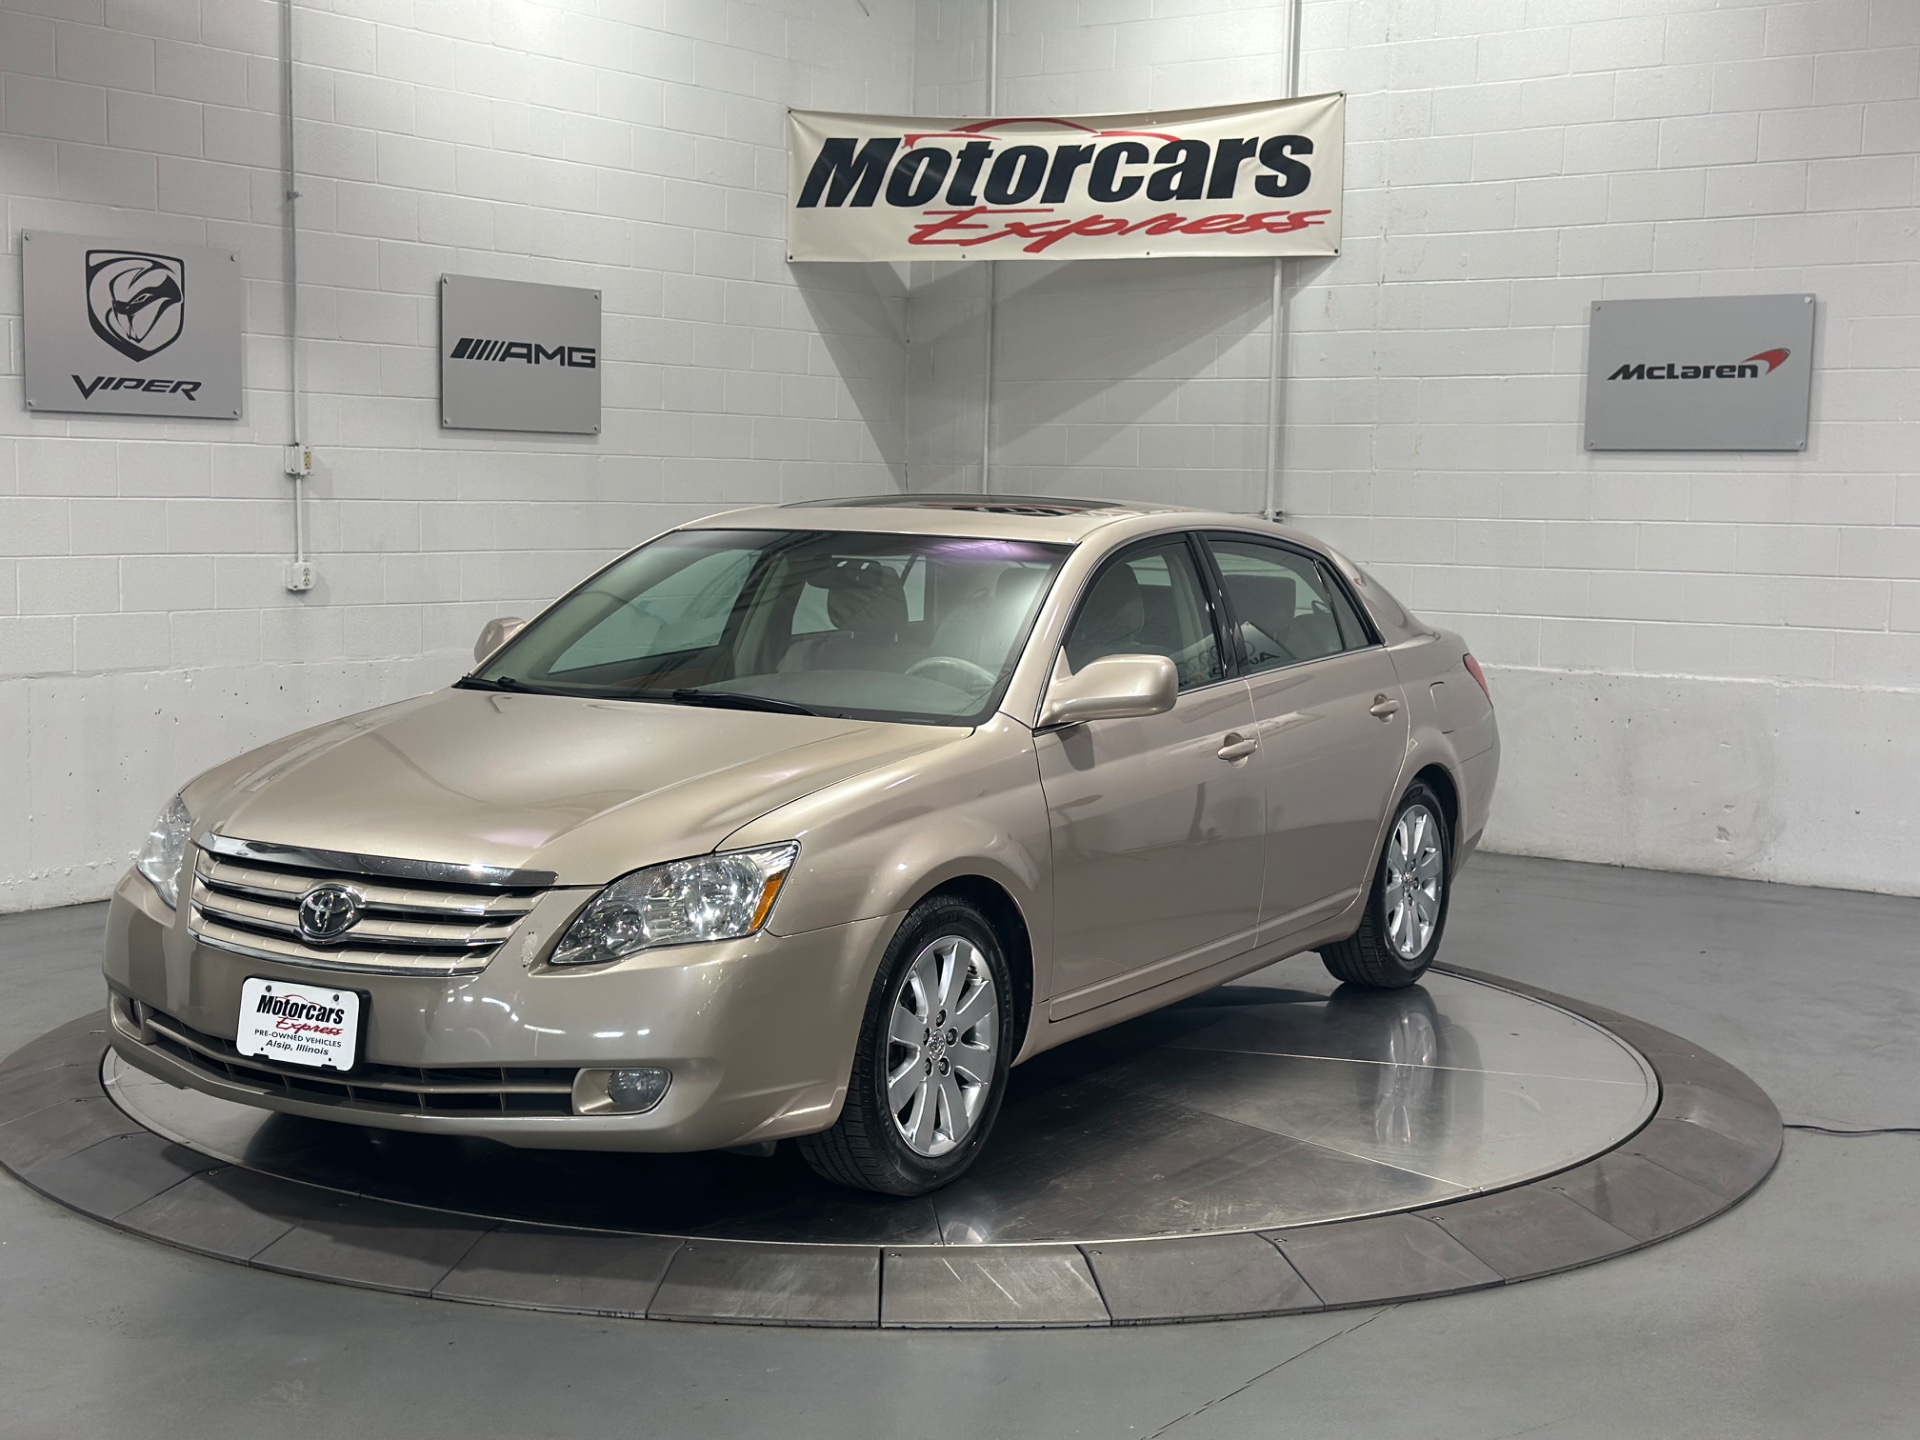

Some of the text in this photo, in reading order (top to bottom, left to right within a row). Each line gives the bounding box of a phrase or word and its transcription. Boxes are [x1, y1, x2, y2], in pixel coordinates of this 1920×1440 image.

[796, 133, 1315, 209] Motorcars
[907, 206, 1333, 254] Express
[498, 341, 596, 368] AMG
[1607, 363, 1759, 380] McLaren
[71, 374, 202, 401] VIPER
[256, 994, 345, 1025] Motorcars
[254, 1028, 342, 1048] PRE-OWNED VEHICLES
[275, 1016, 344, 1036] Express
[265, 1039, 330, 1056] Alsip, Illinois
